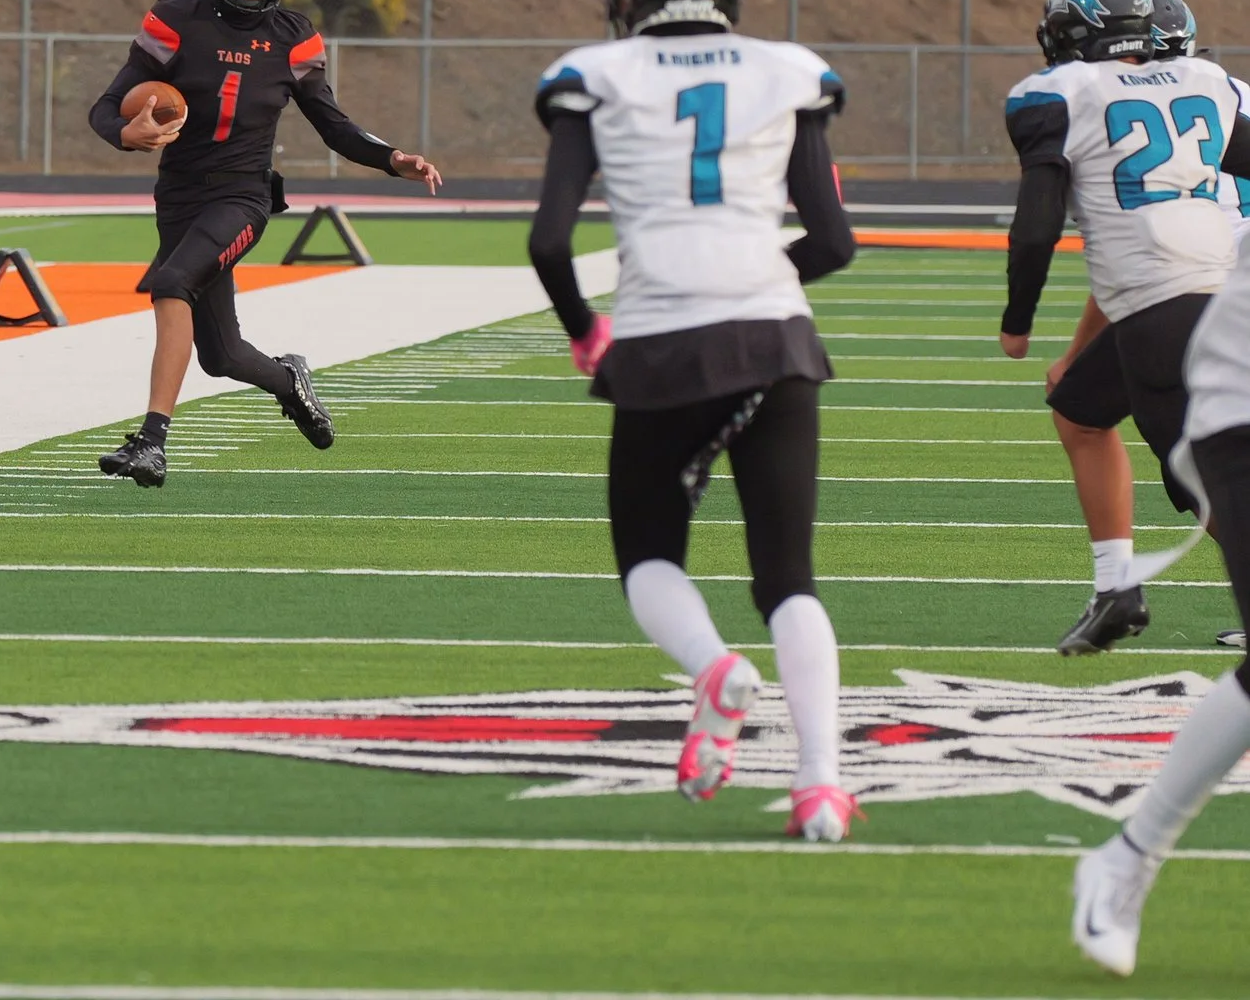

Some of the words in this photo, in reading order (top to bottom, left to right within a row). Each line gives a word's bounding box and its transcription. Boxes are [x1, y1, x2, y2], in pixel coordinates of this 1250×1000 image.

[216, 49, 252, 66] TAOS
[212, 70, 243, 142] 1
[674, 81, 727, 206] 1
[1105, 95, 1225, 211] 23
